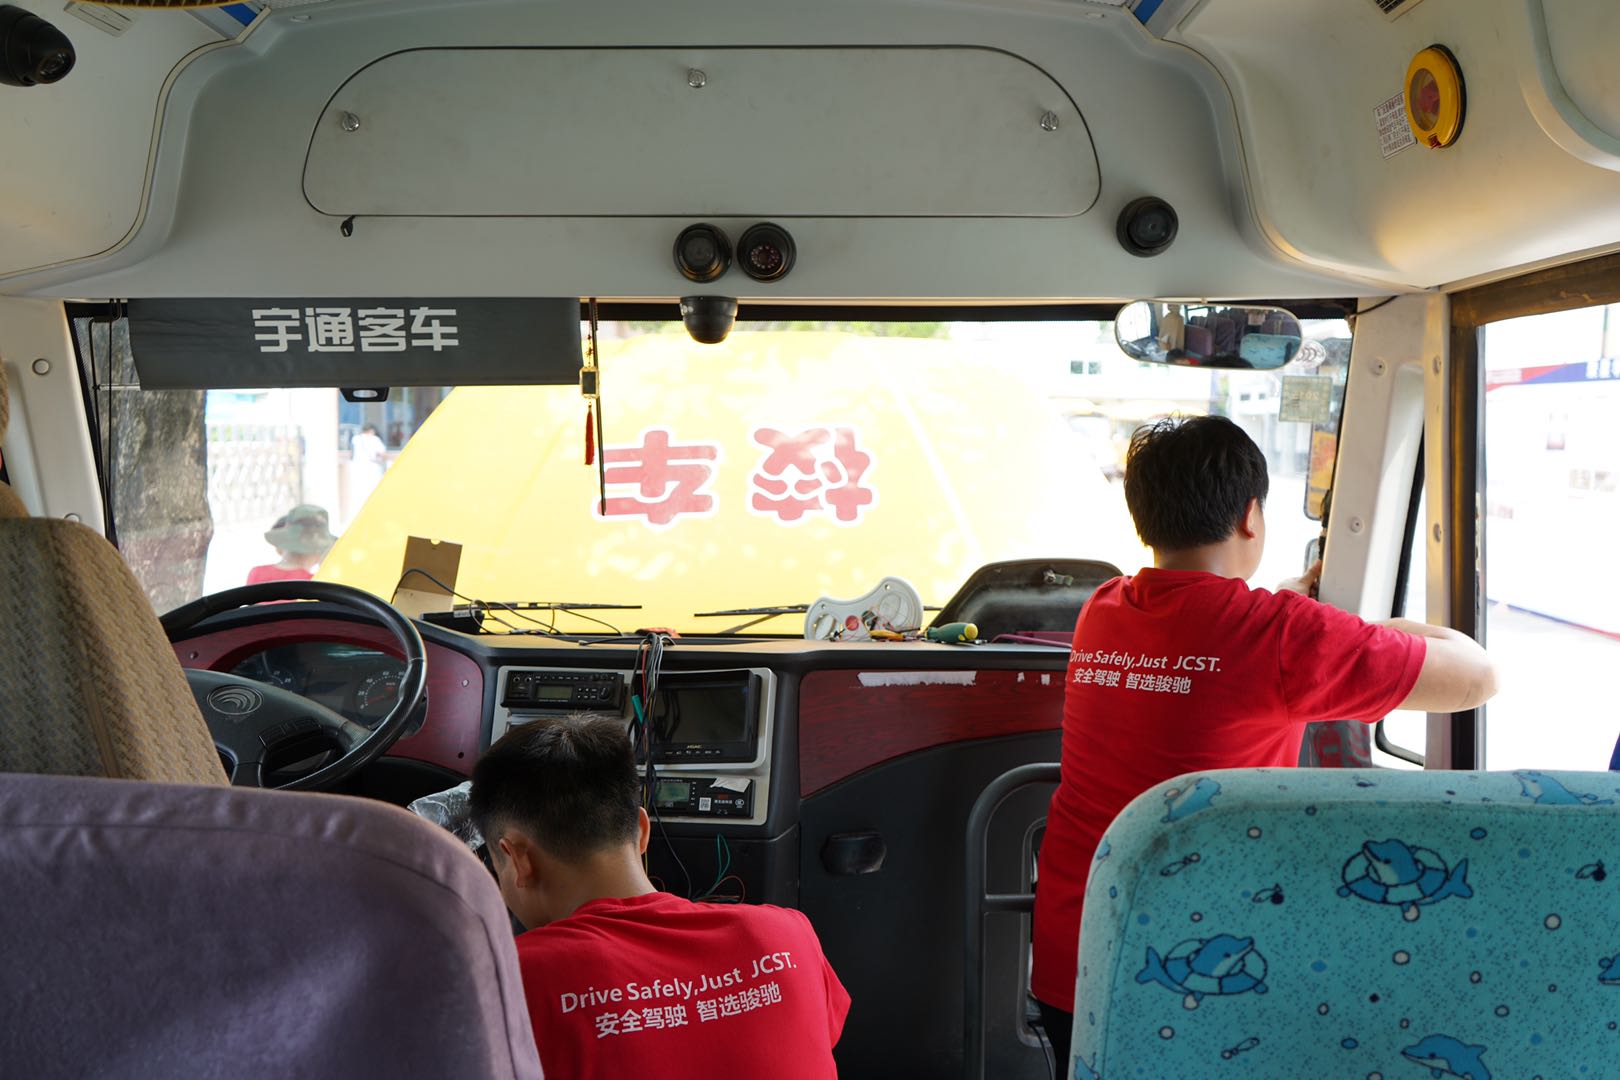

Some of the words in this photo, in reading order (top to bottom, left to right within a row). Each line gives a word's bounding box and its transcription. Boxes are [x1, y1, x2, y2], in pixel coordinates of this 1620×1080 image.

[252, 307, 459, 352] 宇通客车
[1070, 649, 1093, 663] Drive
[1173, 656, 1221, 672] JCST.
[1073, 668, 1121, 687] 安全驾驶
[1125, 672, 1192, 694] 智选骏驰
[560, 986, 623, 1013] Drive
[751, 951, 797, 979] JCST.
[595, 1003, 689, 1039] 安全驾驶
[696, 981, 782, 1023] 智选骏驰
